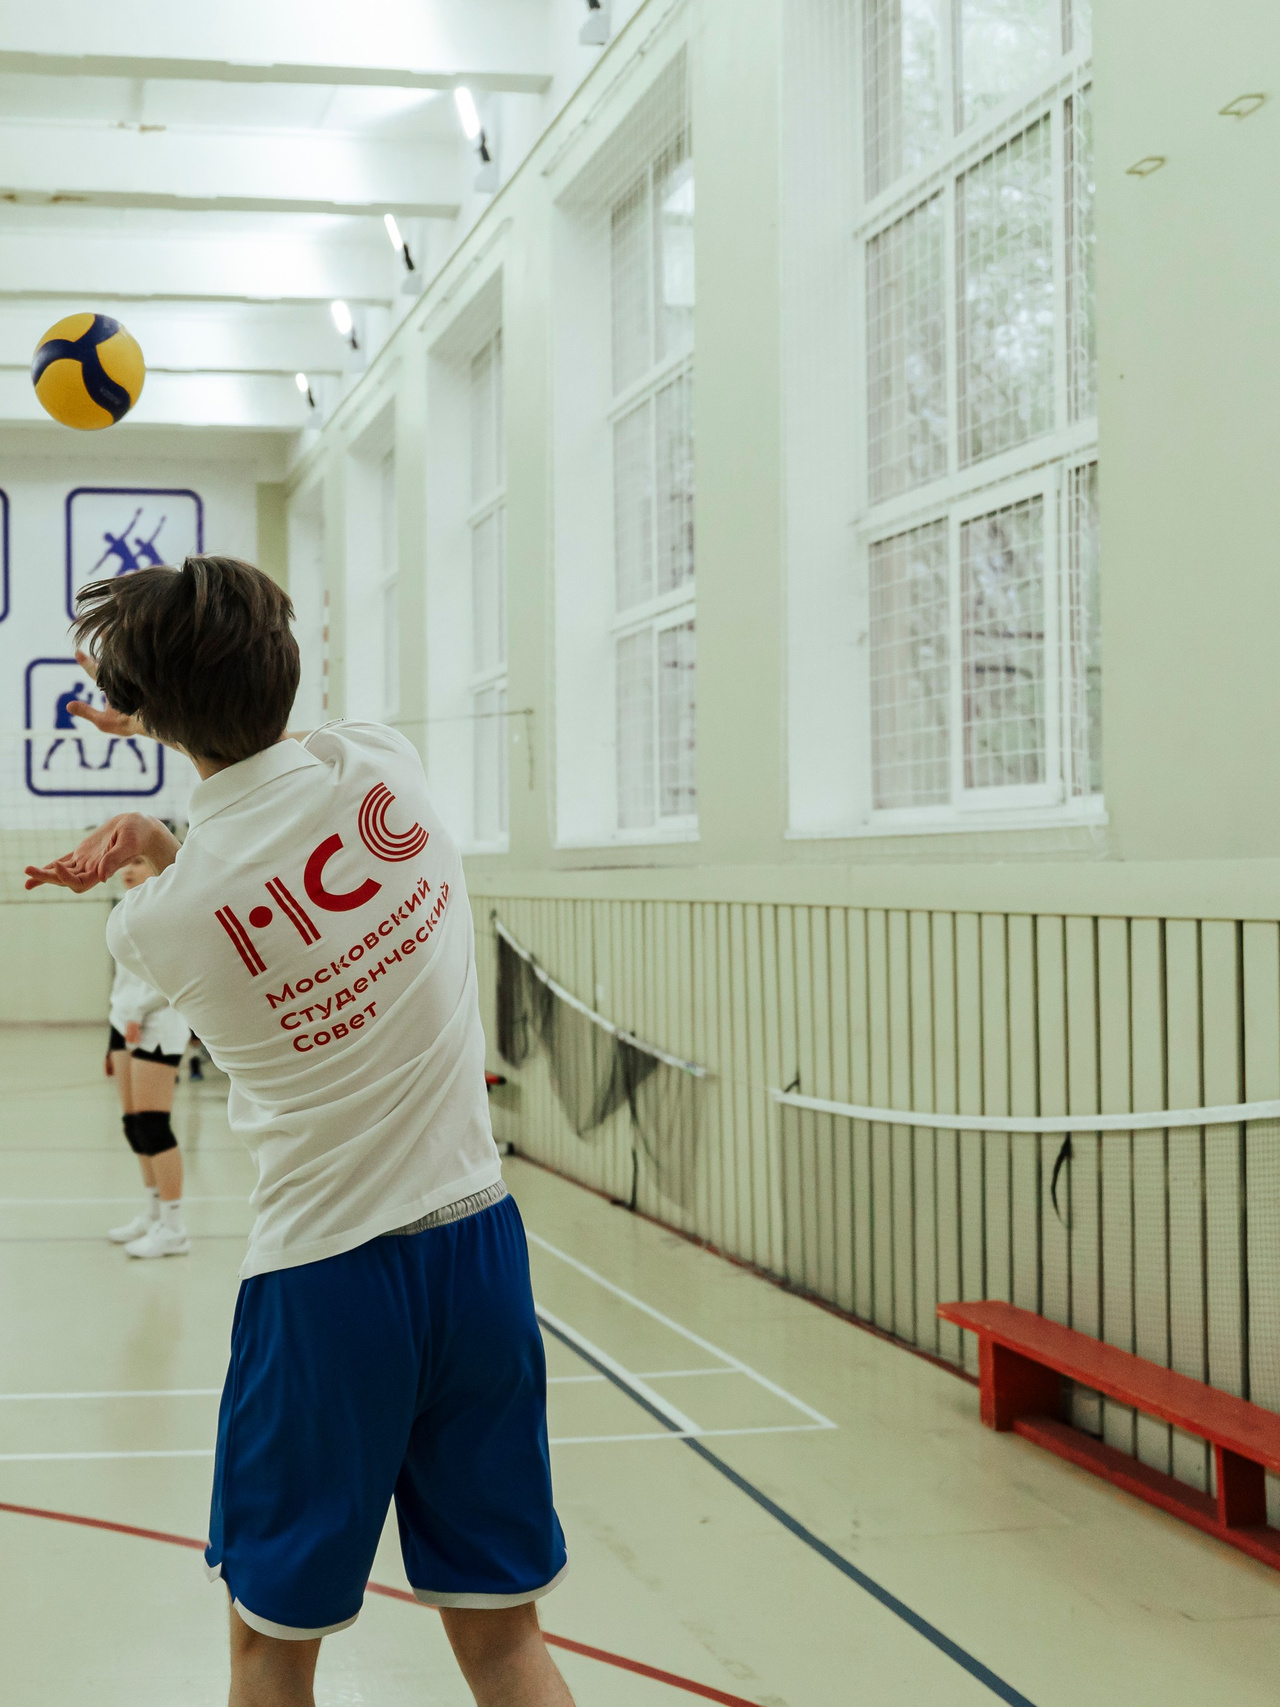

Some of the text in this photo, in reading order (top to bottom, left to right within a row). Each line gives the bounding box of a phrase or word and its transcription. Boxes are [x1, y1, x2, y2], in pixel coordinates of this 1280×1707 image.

[265, 876, 431, 1009] Московский
[280, 881, 450, 1031] Студенческий
[293, 1001, 378, 1053] Совет
